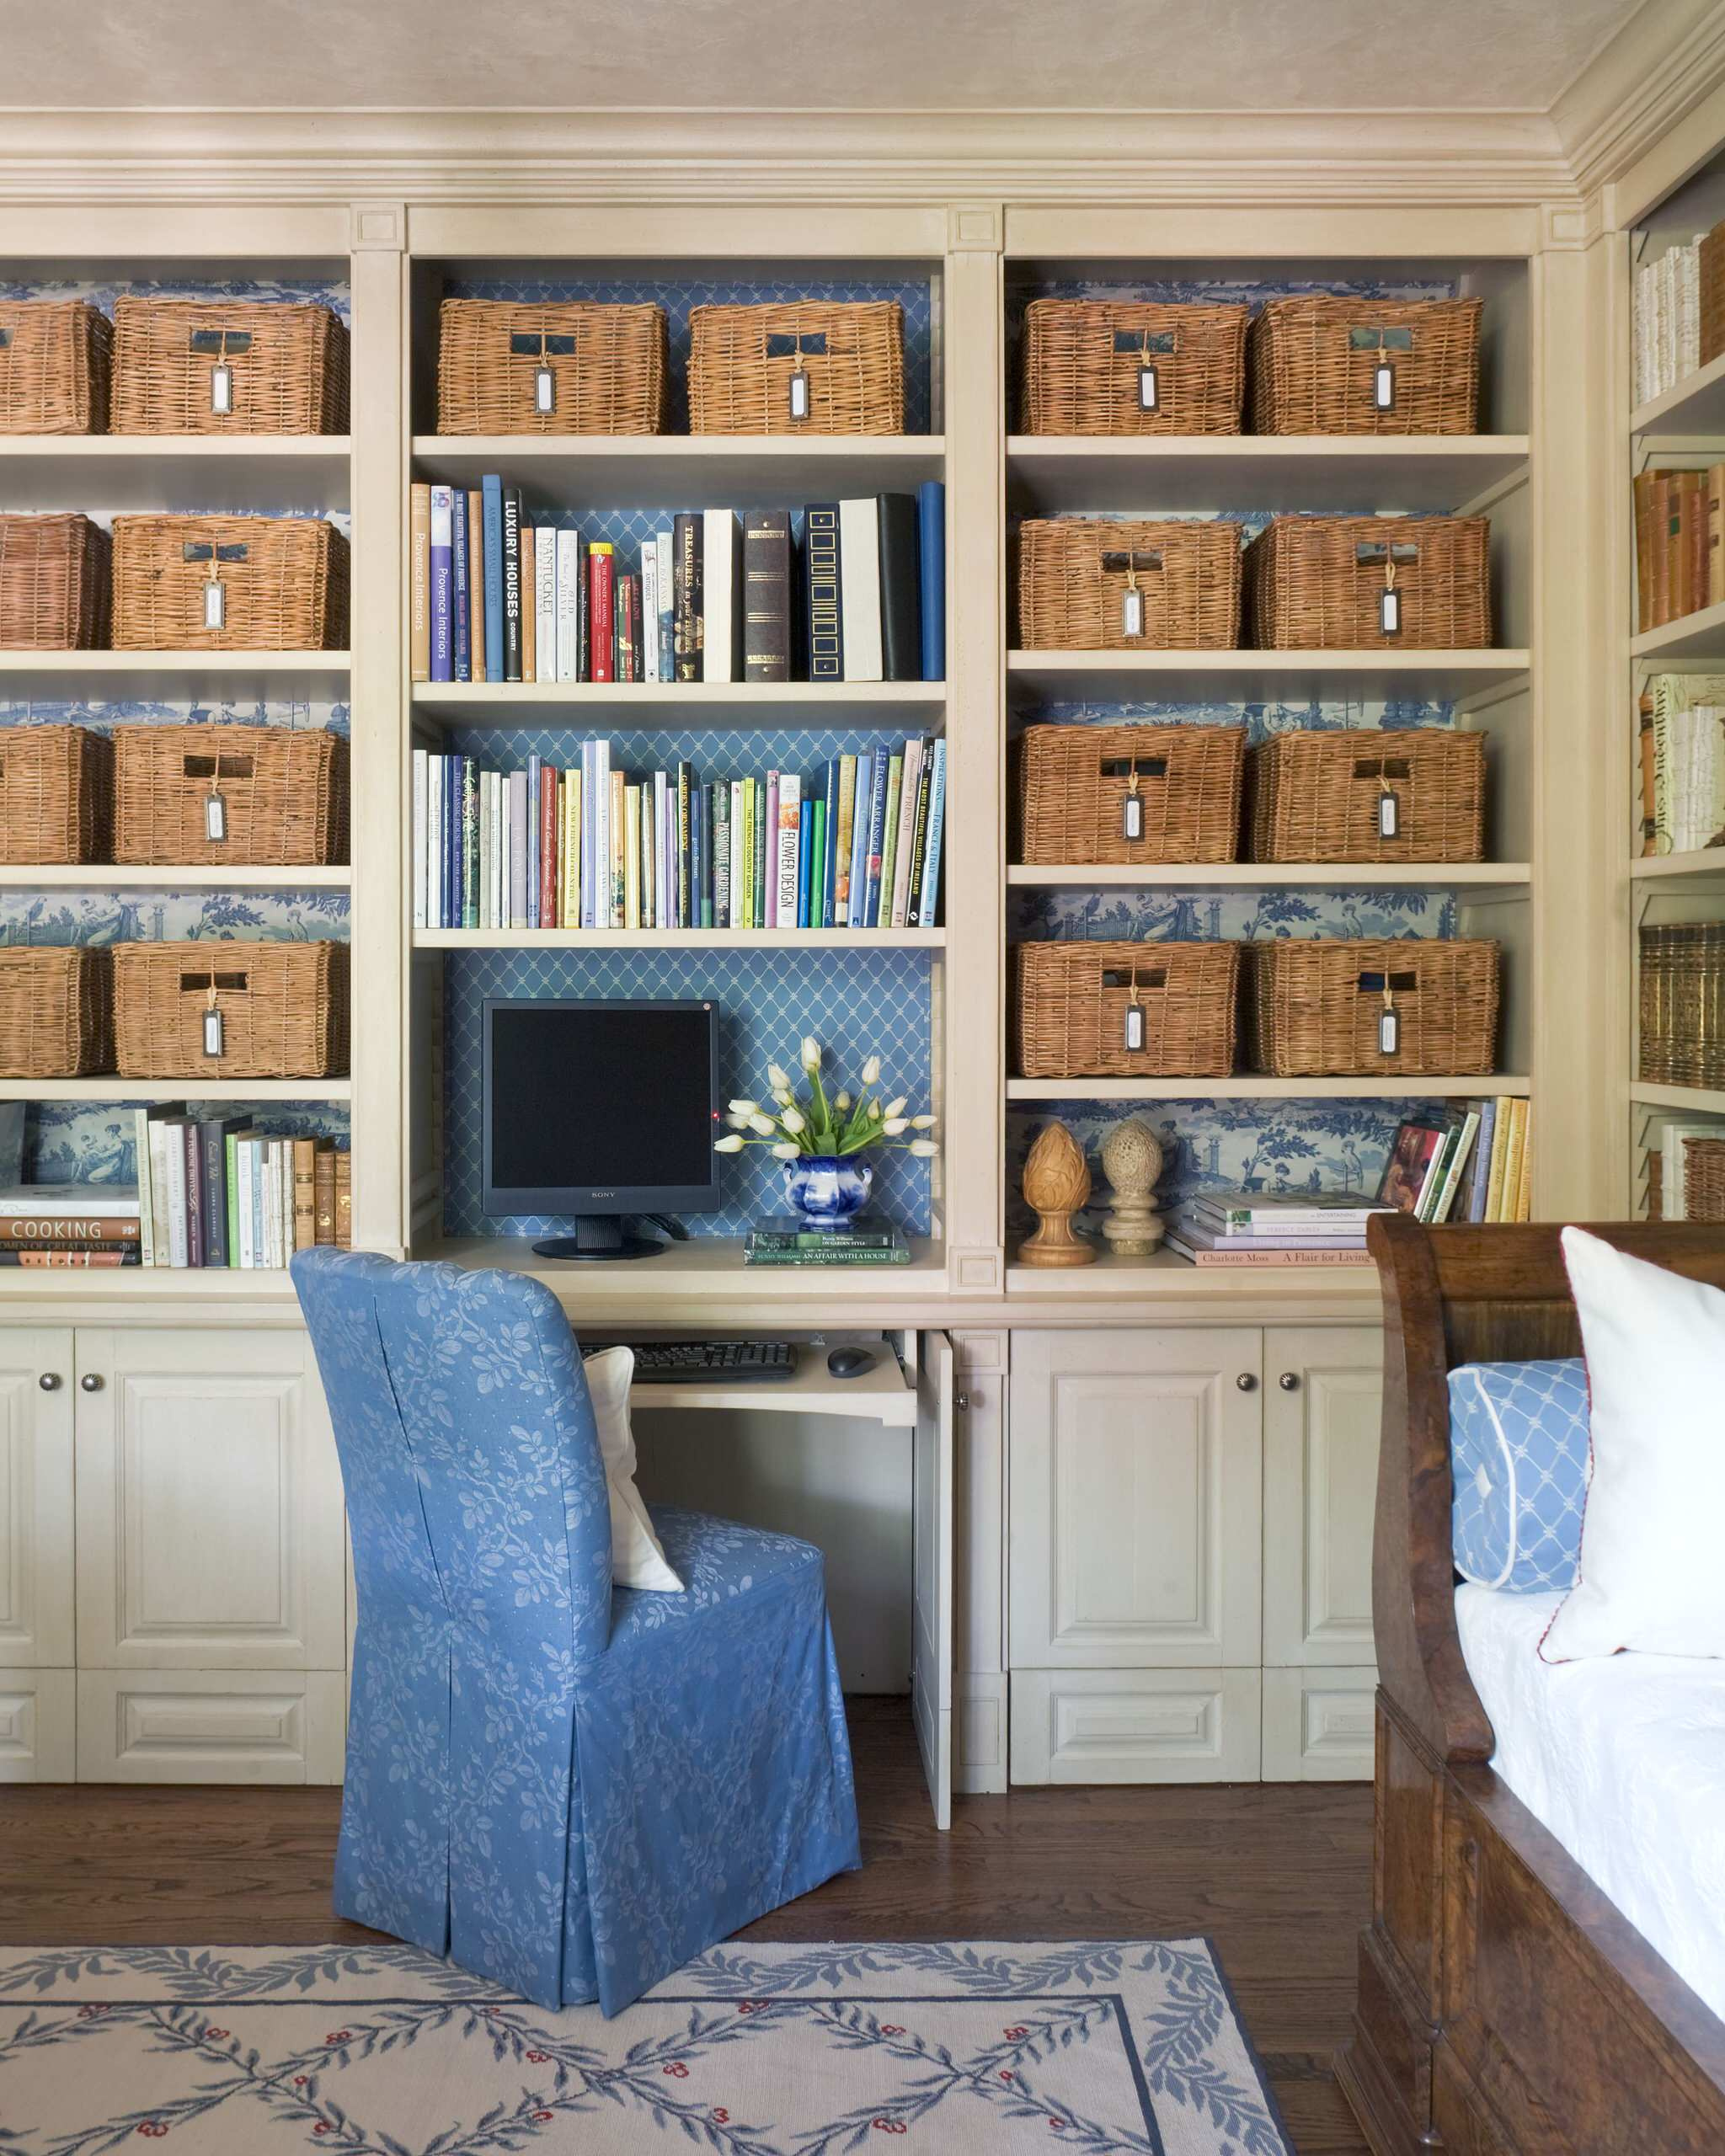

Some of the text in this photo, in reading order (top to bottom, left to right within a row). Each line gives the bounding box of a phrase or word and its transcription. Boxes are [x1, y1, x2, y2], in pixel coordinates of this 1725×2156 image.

[505, 501, 518, 618] LUXURY HOUSES
[685, 526, 693, 587] TREASURES
[415, 532, 426, 631] Provence Interiors
[543, 537, 553, 616] NANTUCKET
[438, 568, 448, 659] Provence Interiors
[876, 766, 885, 802] FLOWER
[936, 748, 946, 801] INSPIRATIONS
[872, 806, 882, 853] ARRANGER
[903, 796, 914, 831] FRENCH
[918, 805, 927, 835] BEAUTIFUL
[930, 814, 941, 842] FRANCE
[718, 822, 729, 909] PASSIONATE GARDENING
[916, 835, 924, 861] VILLAGES
[928, 853, 937, 873] ITALY
[780, 832, 796, 908] FLOWER DESIGN
[12, 1221, 101, 1239] COOKING
[84, 1242, 110, 1251] TASTE
[1203, 1254, 1269, 1262] Charlotte Moss
[1282, 1252, 1370, 1263] A Flair for Living
